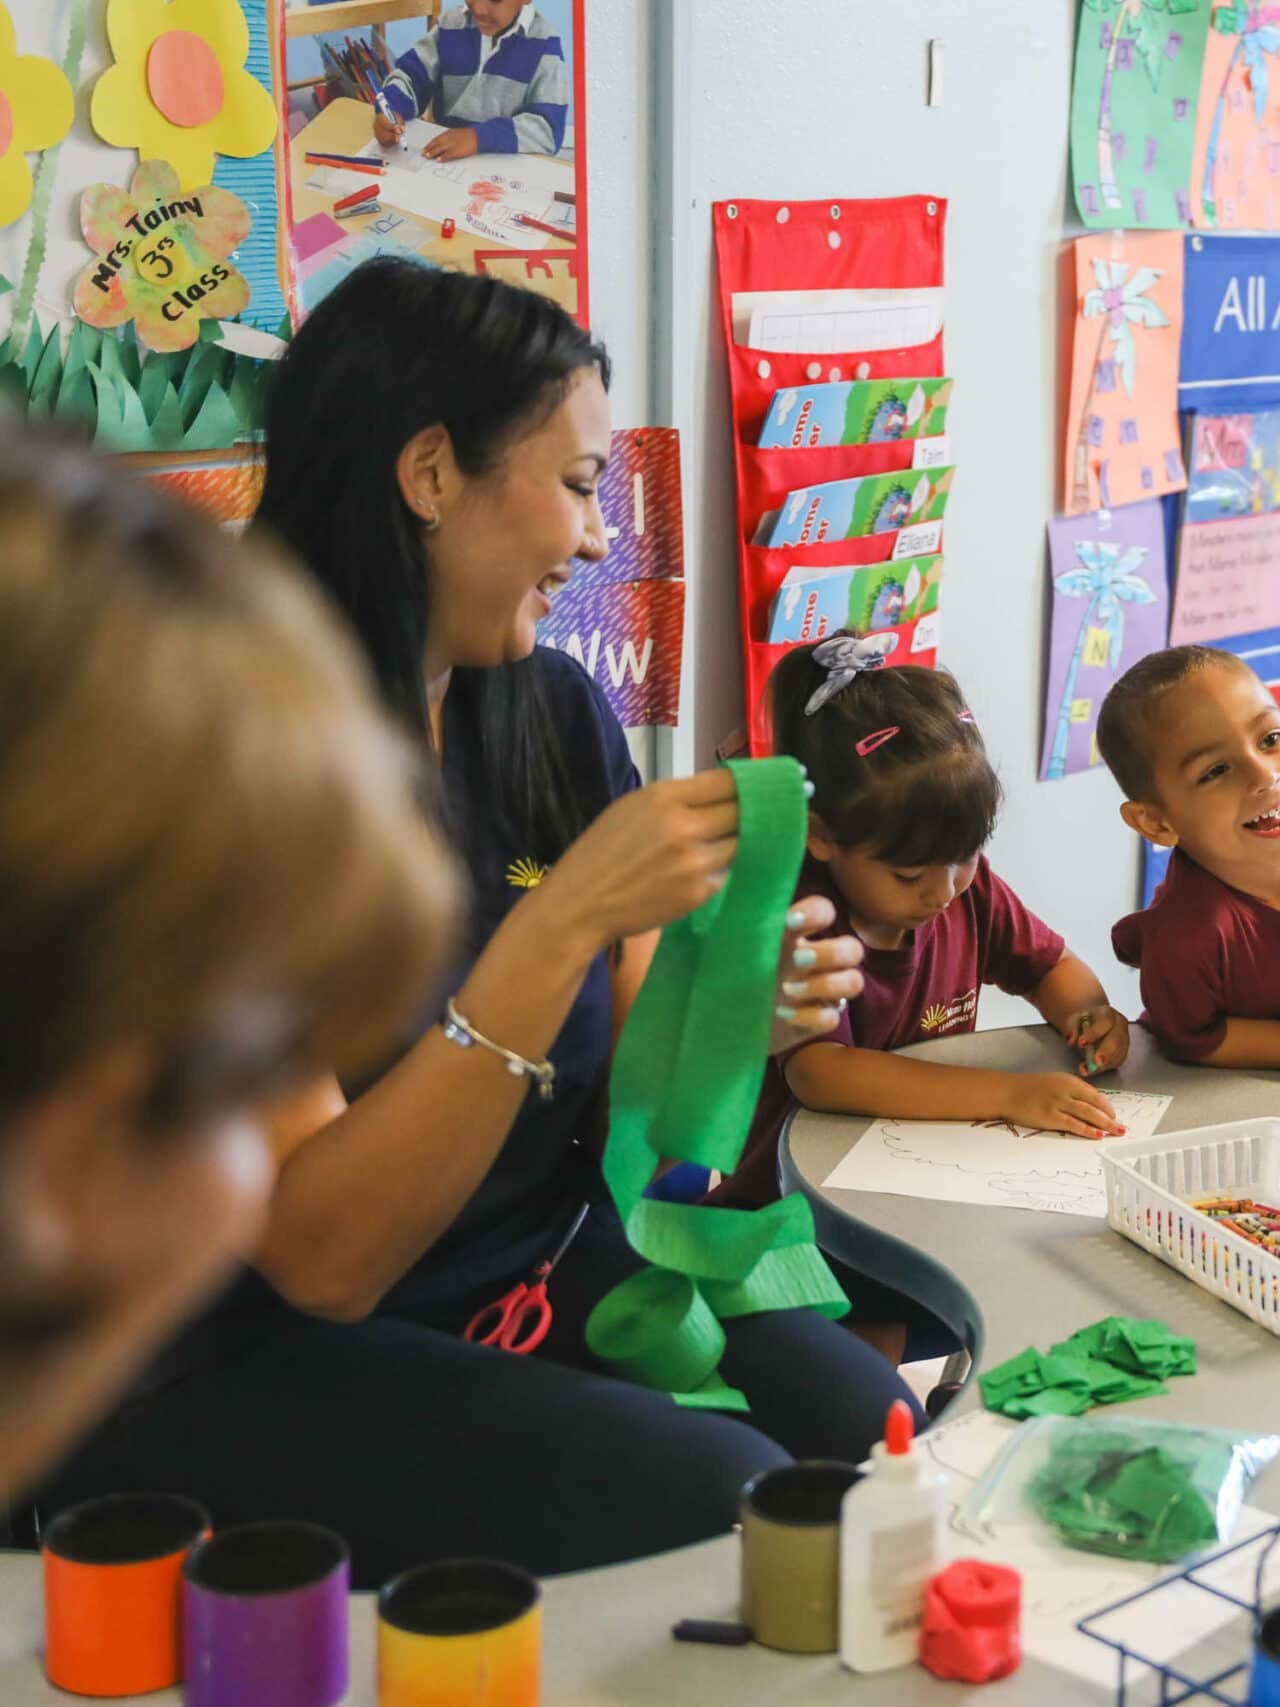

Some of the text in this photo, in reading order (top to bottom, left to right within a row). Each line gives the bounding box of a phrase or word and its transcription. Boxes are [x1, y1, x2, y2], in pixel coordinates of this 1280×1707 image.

[91, 240, 133, 293] Mrs.
[161, 264, 230, 322] Class
[1213, 275, 1266, 333] All
